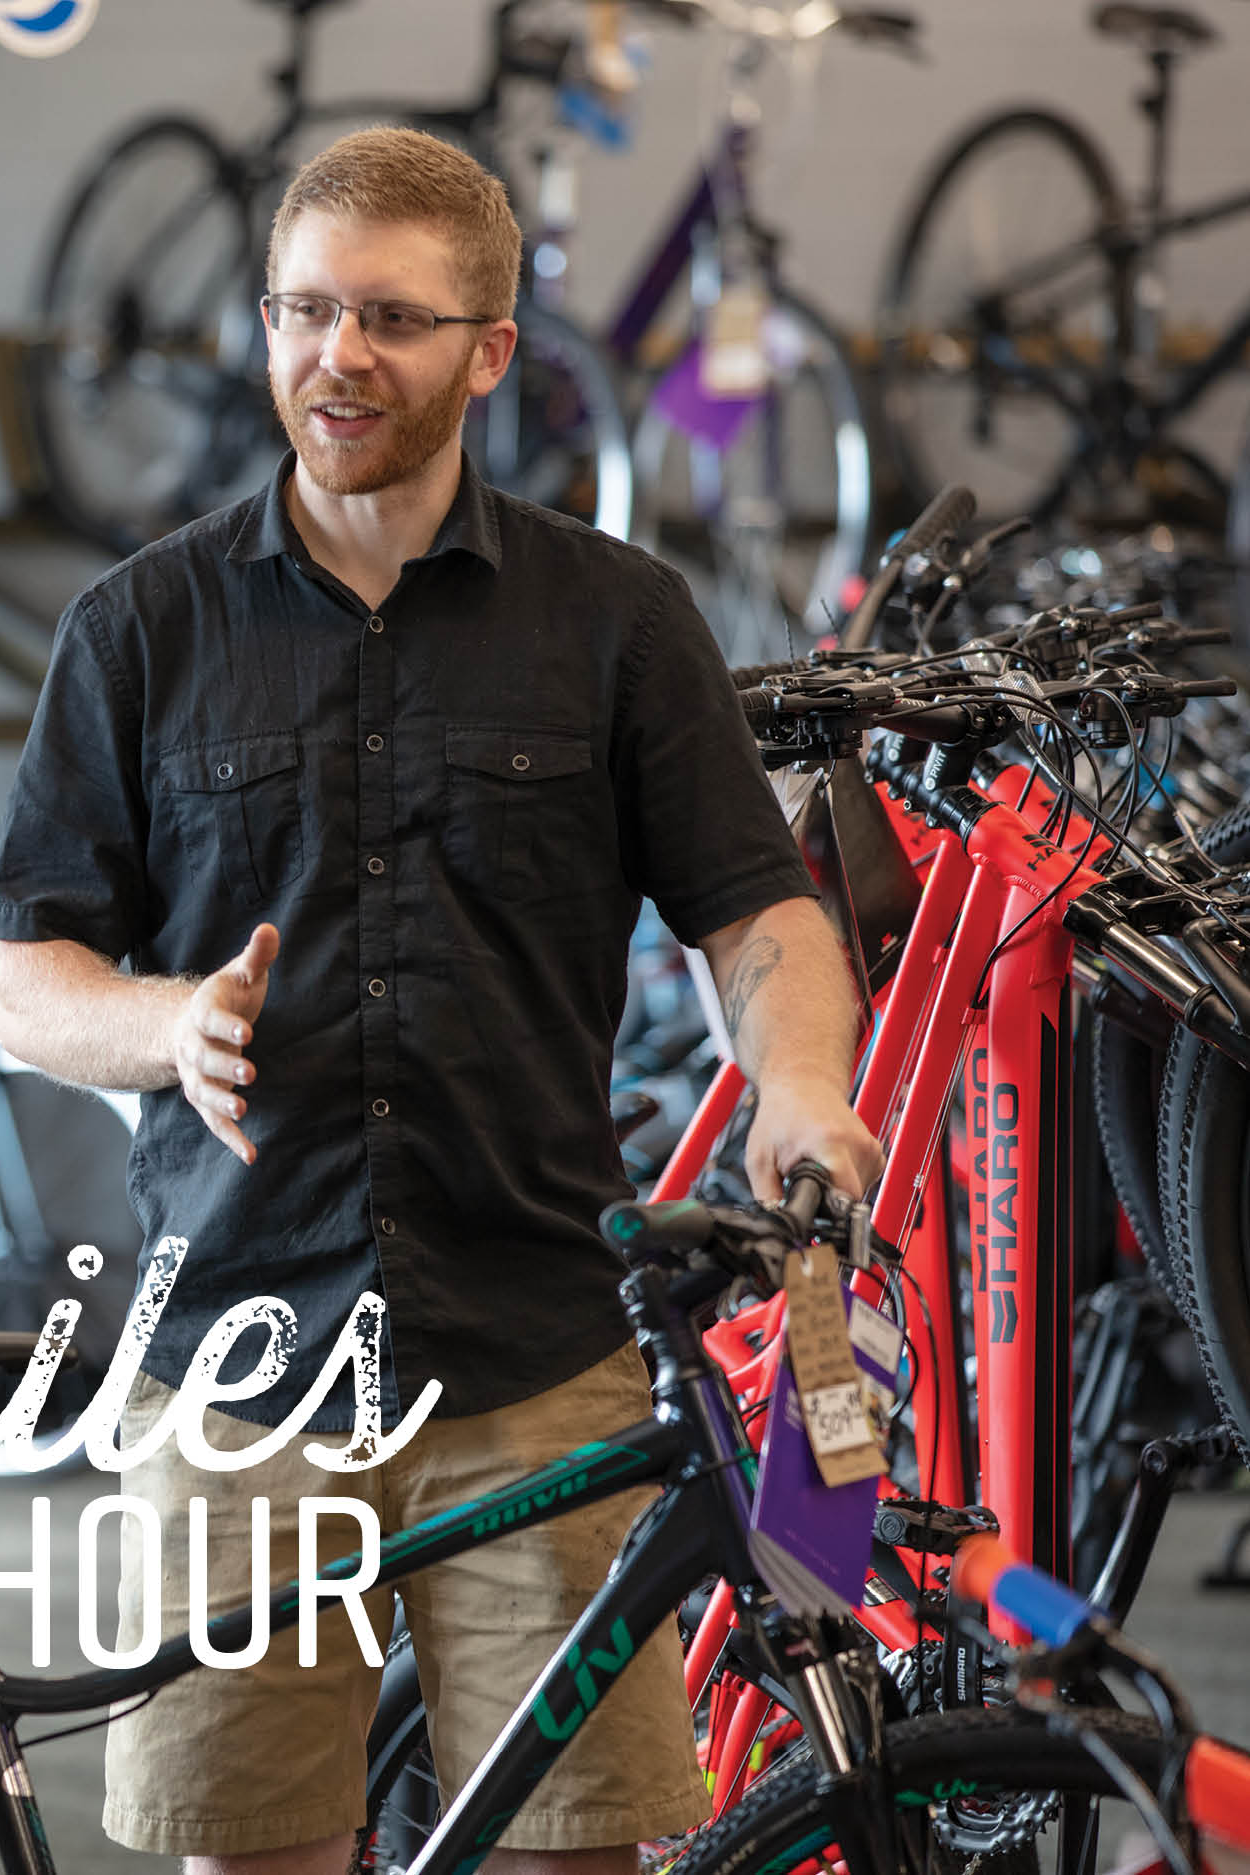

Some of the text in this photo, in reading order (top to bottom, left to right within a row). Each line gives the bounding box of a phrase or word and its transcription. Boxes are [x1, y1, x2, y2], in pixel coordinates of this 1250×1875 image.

[930, 750, 947, 778] PIVIT
[990, 1082, 1019, 1283] HARO
[957, 1647, 967, 1701] SHIMANO
